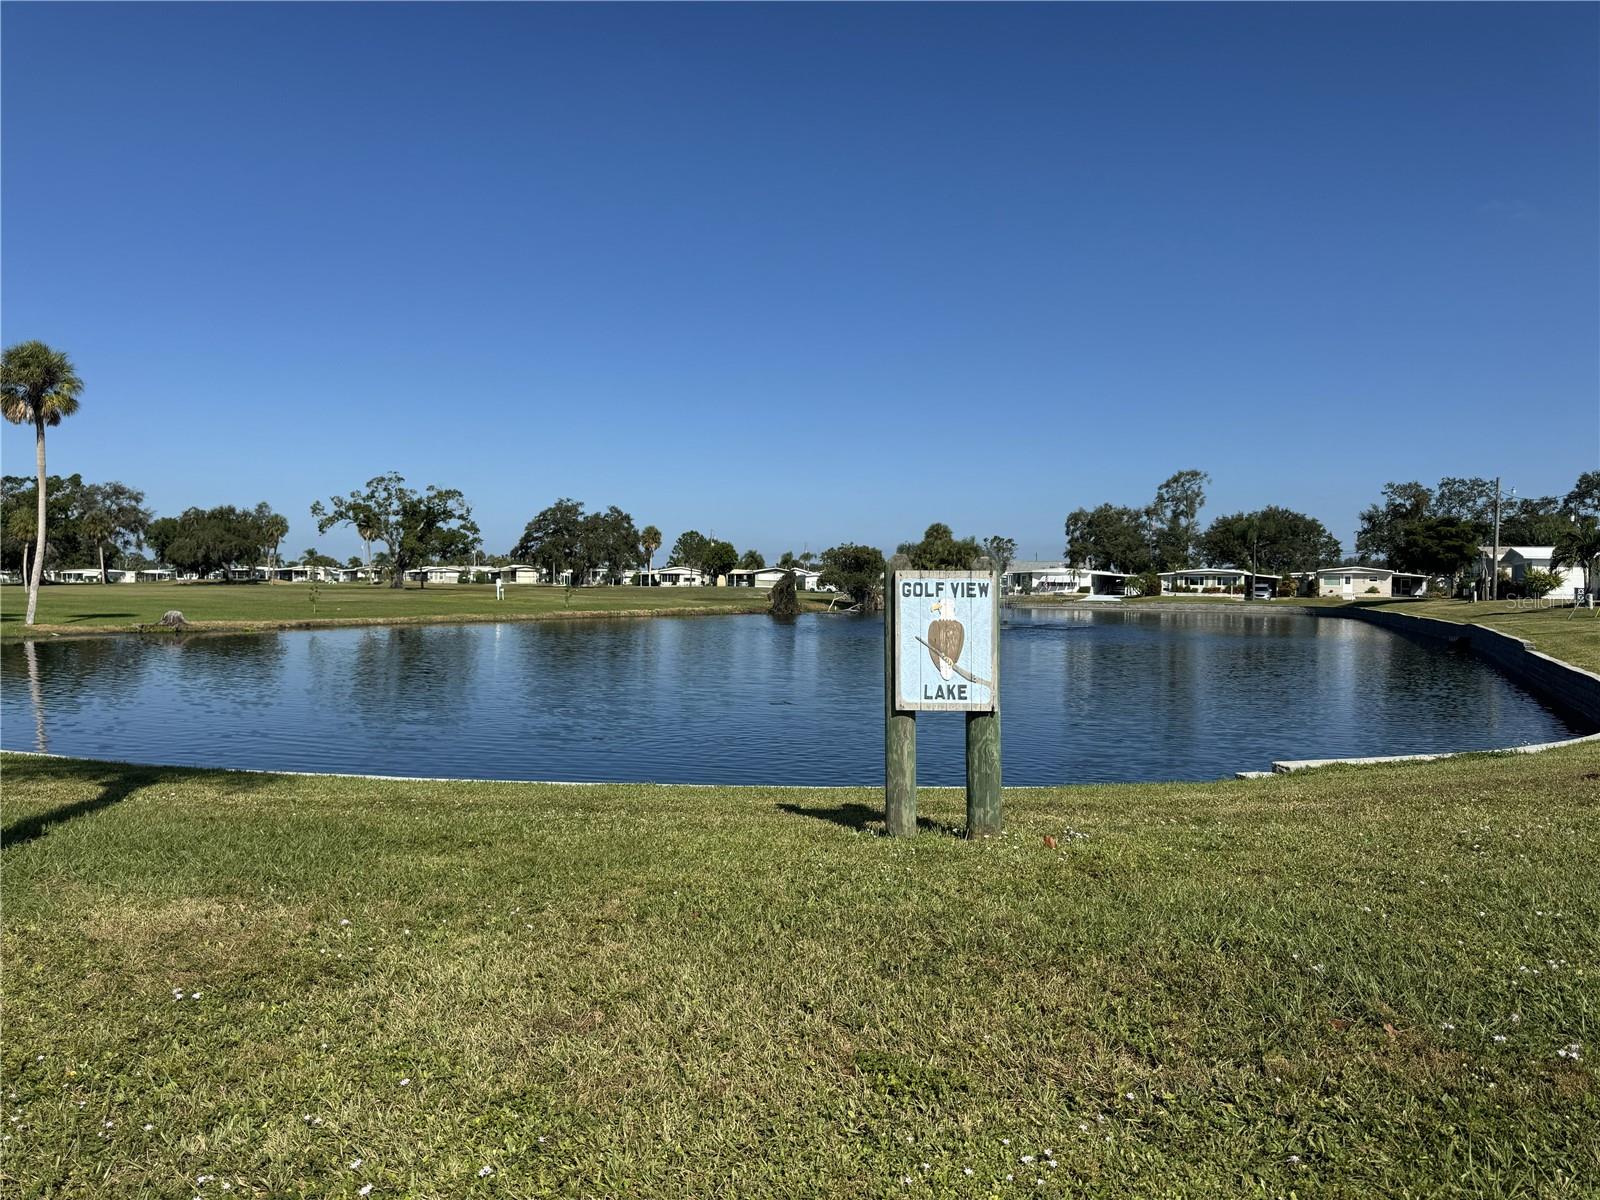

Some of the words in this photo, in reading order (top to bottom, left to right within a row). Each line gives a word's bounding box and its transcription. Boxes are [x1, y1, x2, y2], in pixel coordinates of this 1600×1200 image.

[901, 582, 945, 598] GOLF
[950, 582, 990, 598] VIEW
[924, 684, 968, 700] LAKE
